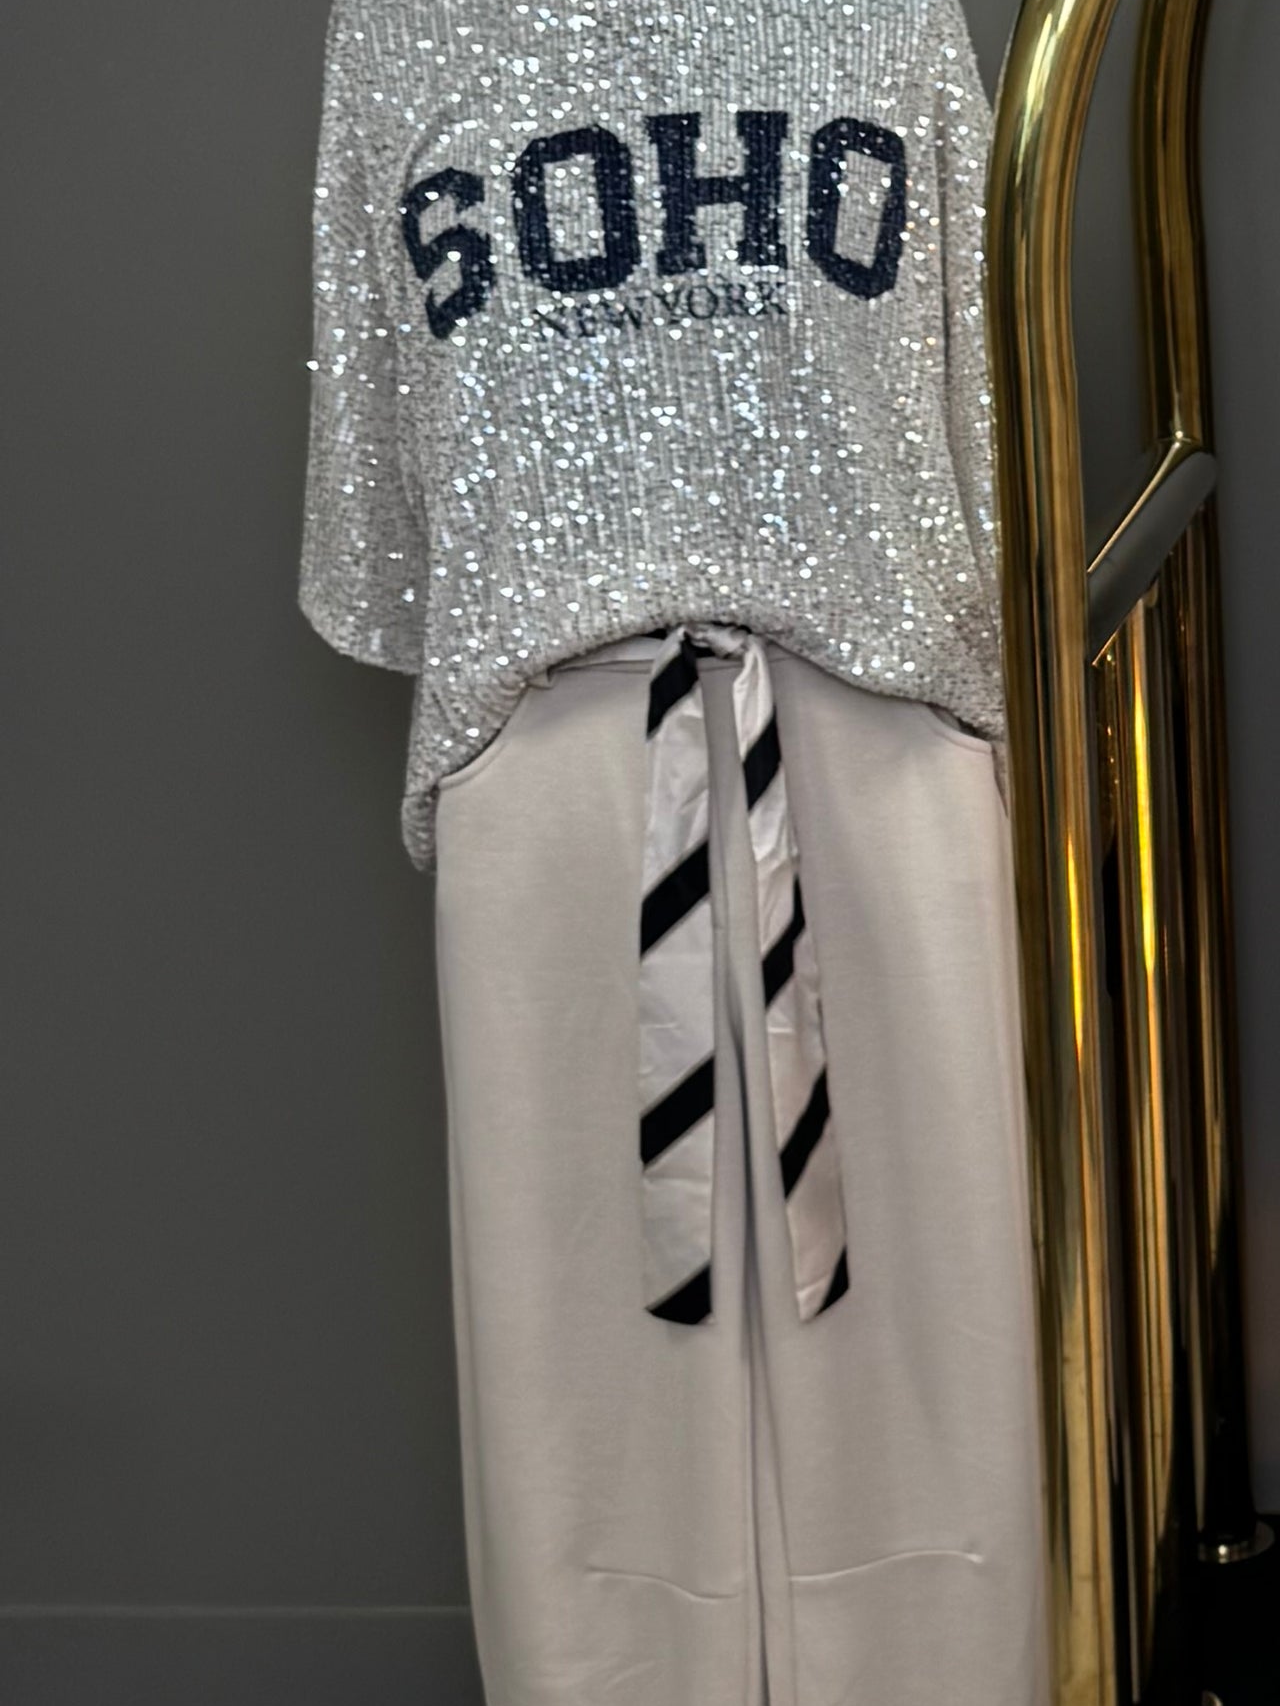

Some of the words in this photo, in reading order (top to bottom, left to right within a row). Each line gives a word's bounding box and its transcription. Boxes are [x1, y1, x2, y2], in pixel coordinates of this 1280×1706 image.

[402, 110, 904, 340] SOHO
[532, 295, 643, 340] NEW
[650, 279, 788, 326] YORK
